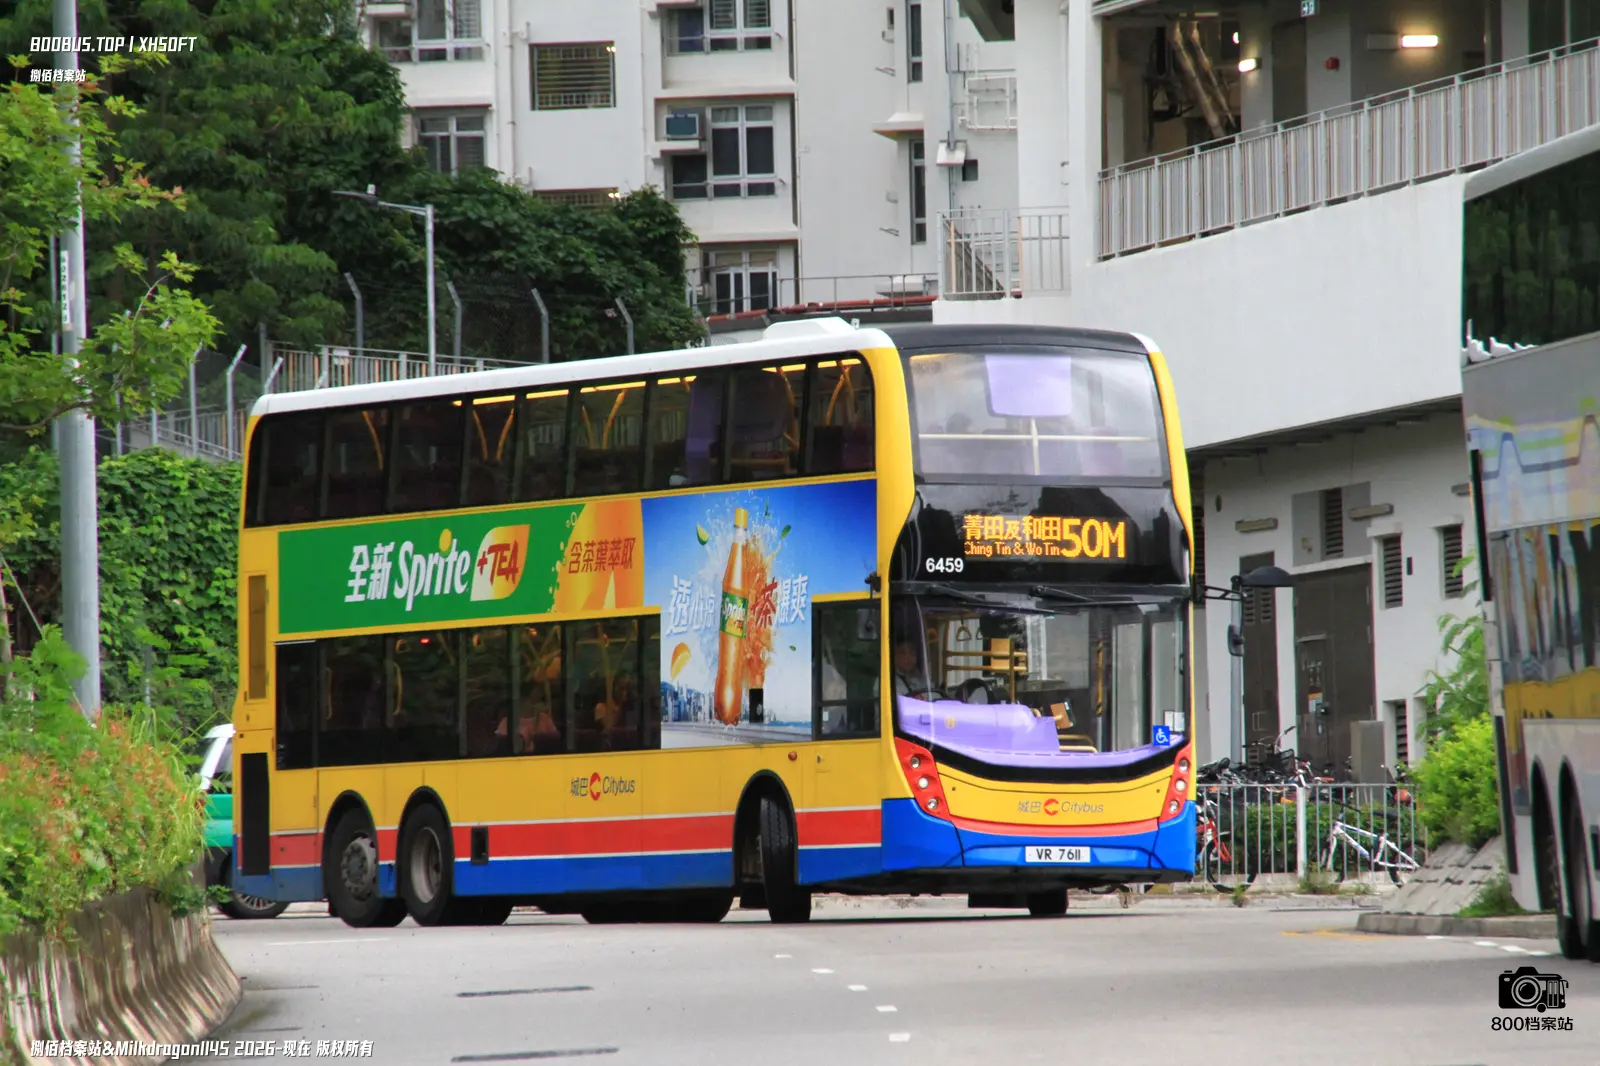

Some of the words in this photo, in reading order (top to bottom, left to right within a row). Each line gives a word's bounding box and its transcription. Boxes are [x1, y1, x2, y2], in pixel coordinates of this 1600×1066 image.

[963, 515, 1061, 541] 菁田及和田
[1061, 518, 1126, 558] 50M
[568, 537, 636, 574] 含茶葉萃取
[965, 541, 993, 557] Ching
[994, 542, 1012, 555] Tin
[1013, 543, 1025, 556] &
[1026, 542, 1043, 556] Wo
[1044, 542, 1061, 556] Tin
[344, 541, 396, 603] 全新
[393, 528, 471, 612] Sprite
[925, 557, 964, 573] 6459
[570, 777, 589, 797] 城巴
[602, 776, 635, 796] Citybus
[1018, 801, 1042, 813] 城巴
[1061, 801, 1104, 814] Citybus
[1036, 848, 1052, 861] VR
[1058, 848, 1081, 861] 7611
